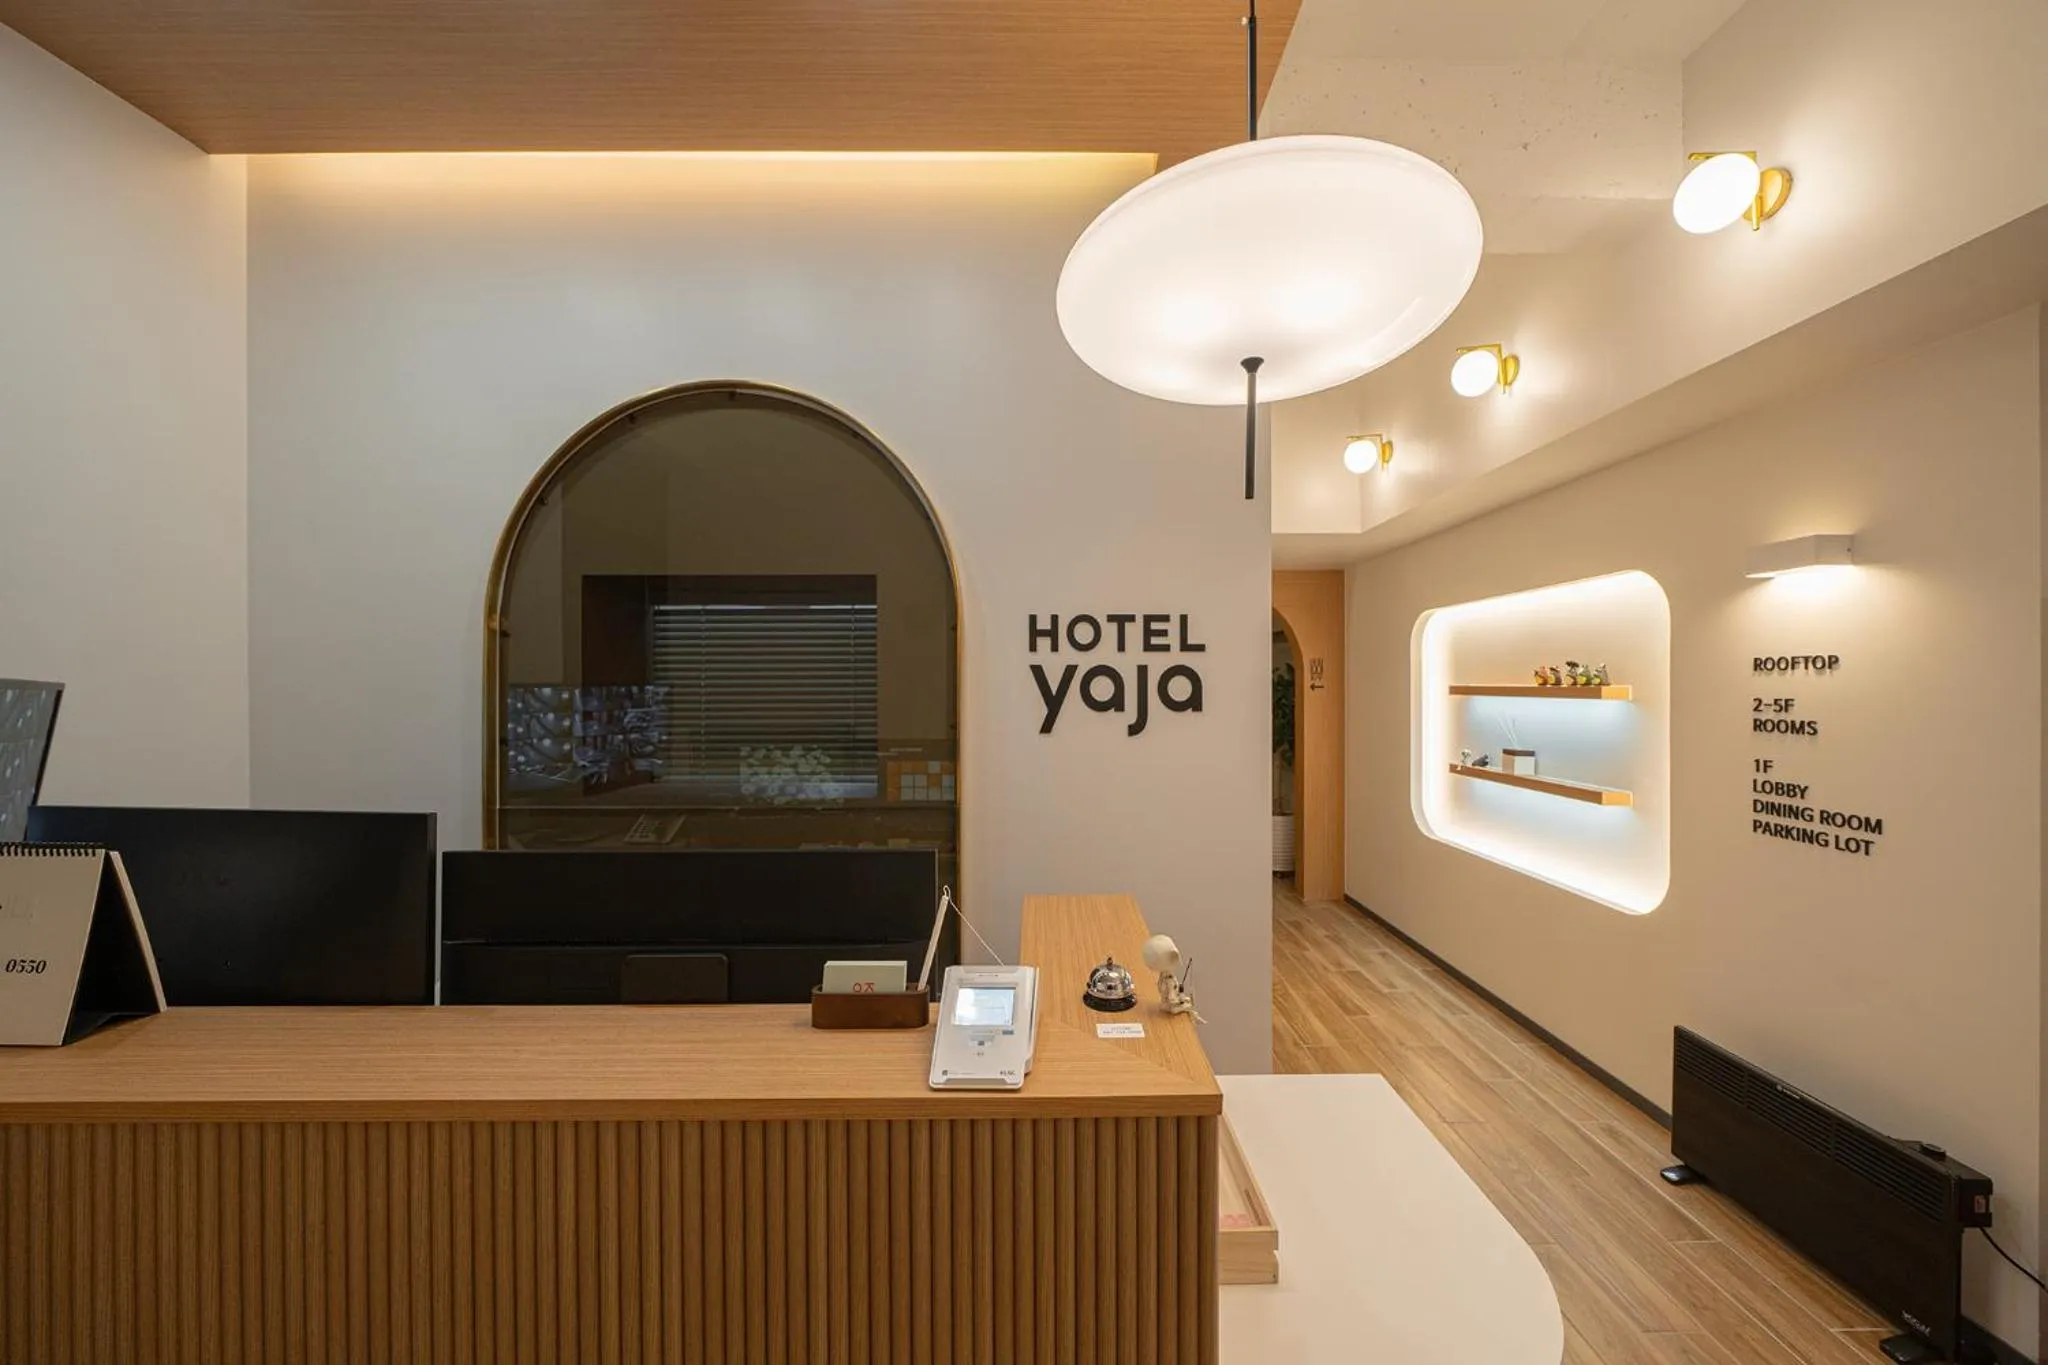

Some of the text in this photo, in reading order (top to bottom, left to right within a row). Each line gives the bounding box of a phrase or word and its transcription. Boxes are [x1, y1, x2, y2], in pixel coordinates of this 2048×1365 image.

[1028, 613, 1206, 653] HOTEL
[1752, 654, 1840, 672] ROOFTOP
[1029, 664, 1203, 737] yaja
[1752, 697, 1795, 714] 2-5F
[1752, 717, 1819, 737] ROOMS
[1752, 758, 1774, 774] 1F
[1752, 778, 1809, 800] LOBBY
[1752, 798, 1884, 836] DINING ROOM
[1752, 818, 1876, 857] PARKING LOT
[5, 958, 47, 975] 0550
